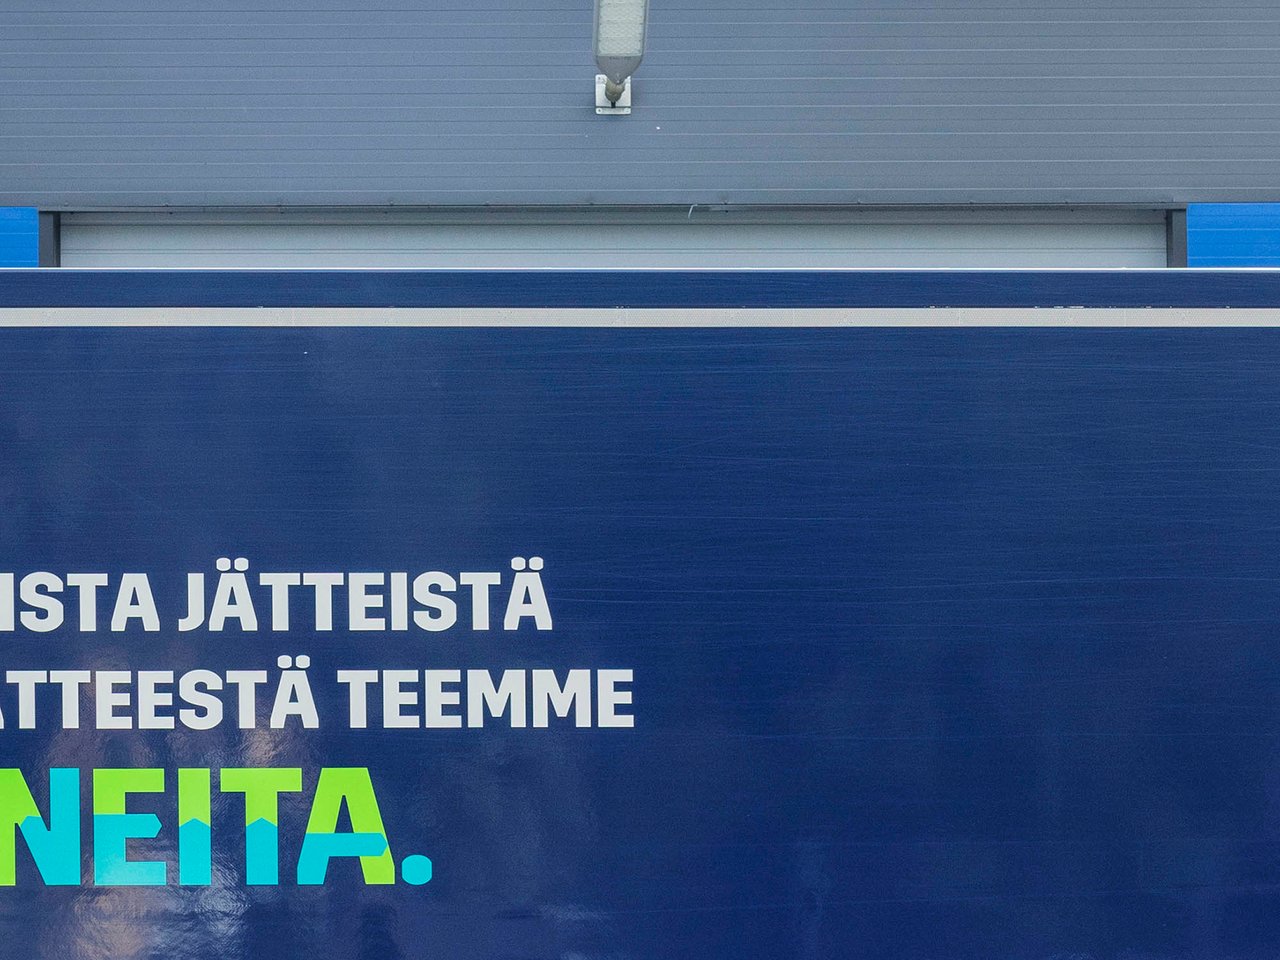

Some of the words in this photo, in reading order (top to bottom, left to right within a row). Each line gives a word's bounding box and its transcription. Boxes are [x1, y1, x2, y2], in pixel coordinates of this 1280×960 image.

[0, 571, 161, 633] ISTA
[178, 556, 553, 632] JÄTTEISTÄ
[0, 655, 320, 730] TTEESTÄ
[337, 669, 635, 729] TEEMME
[0, 766, 433, 886] NEITA.
